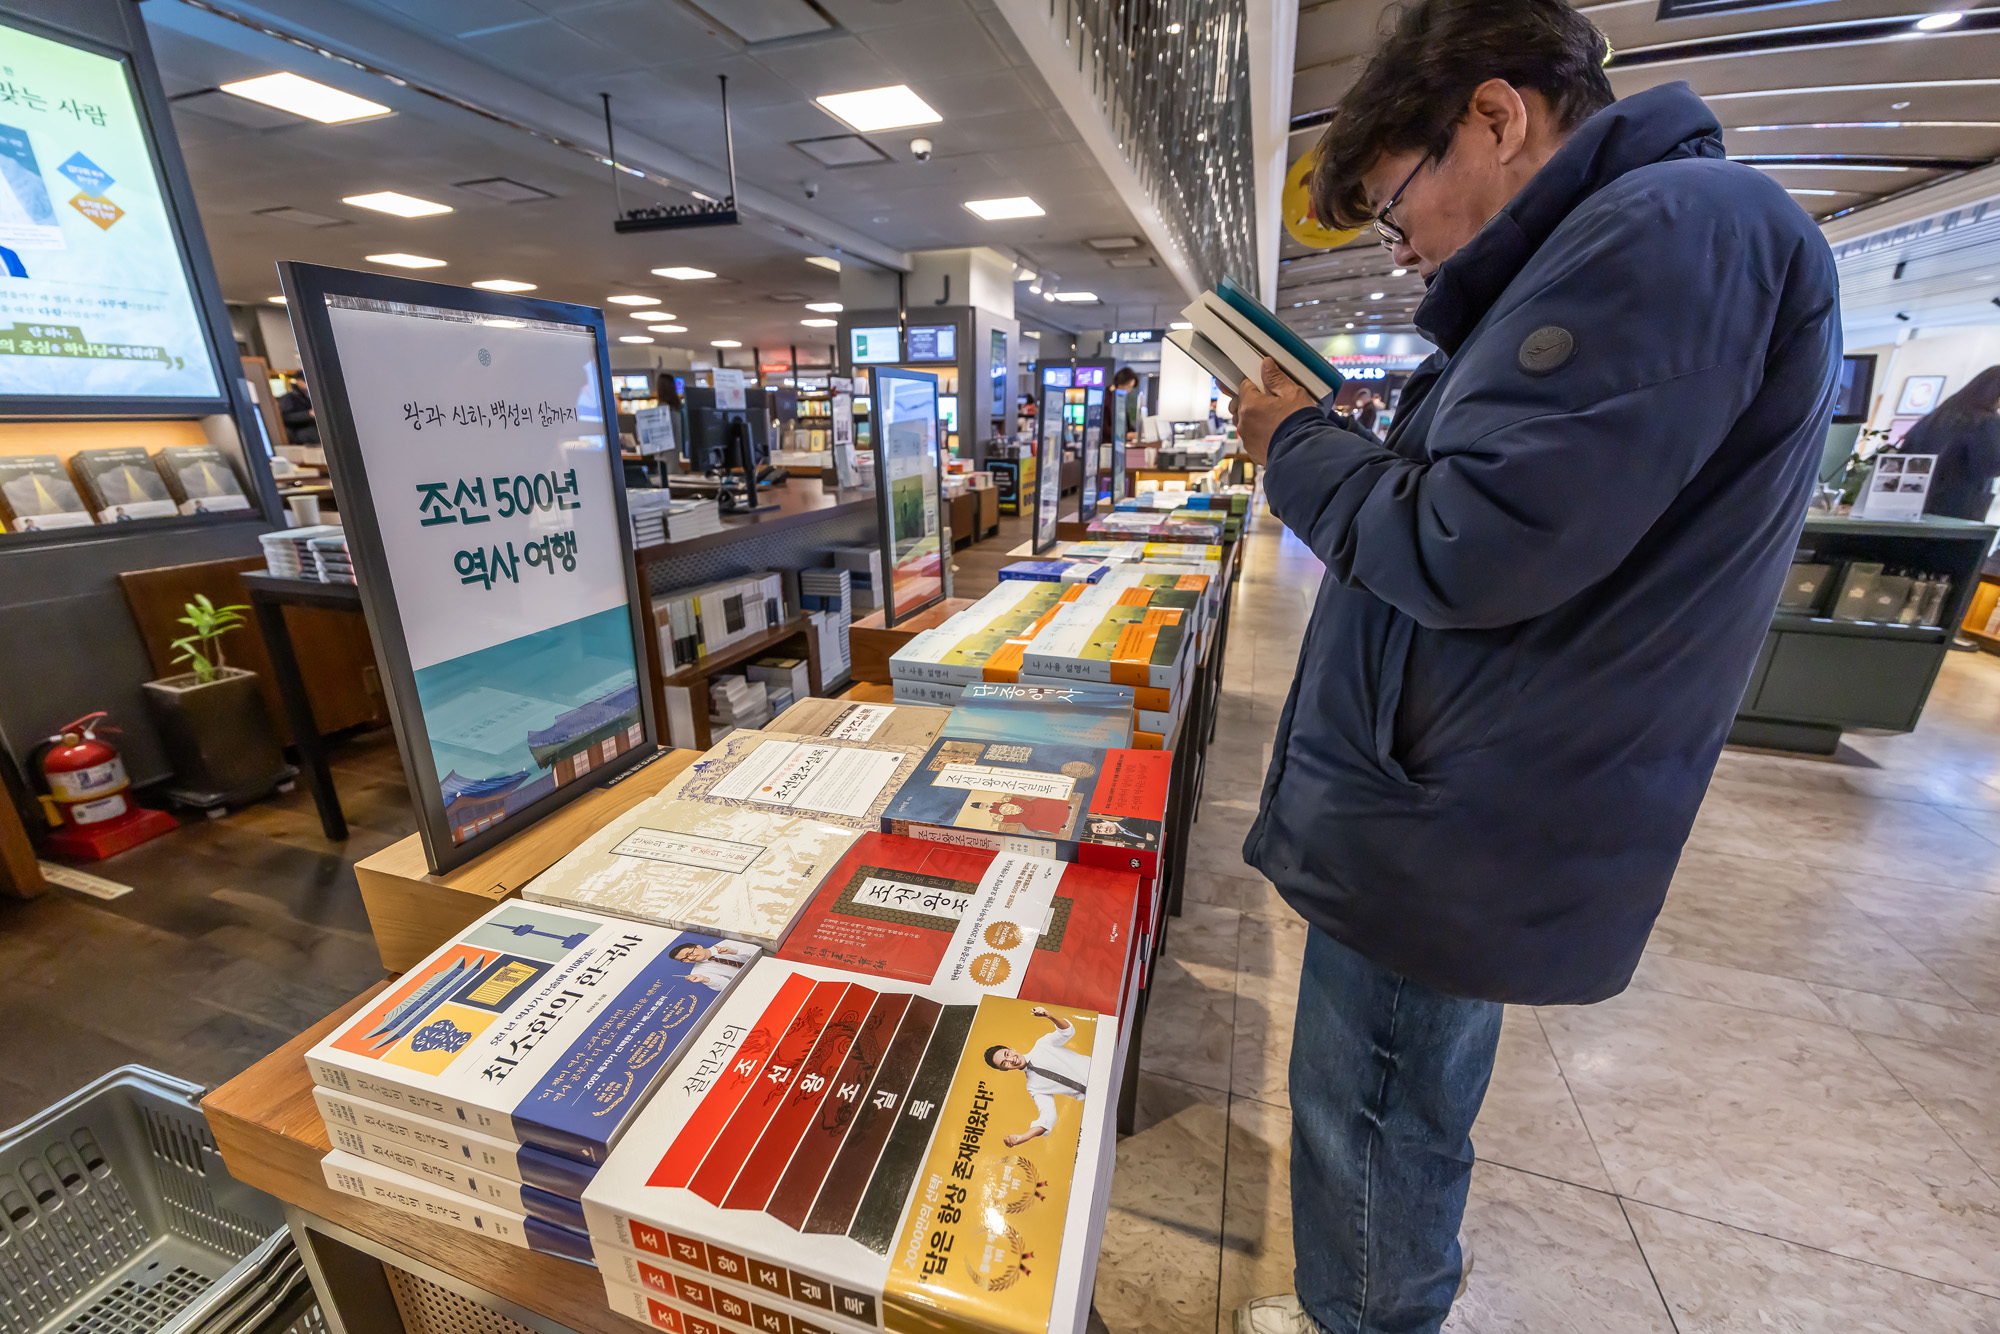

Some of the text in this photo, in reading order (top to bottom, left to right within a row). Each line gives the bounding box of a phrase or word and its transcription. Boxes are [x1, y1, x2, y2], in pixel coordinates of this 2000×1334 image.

[59, 99, 107, 127] 사람
[935, 274, 950, 306] J
[403, 401, 446, 430] 왕과
[537, 401, 578, 428] 삶까지
[416, 468, 581, 527] 조선 500년
[454, 530, 578, 590] 역사 여행
[898, 666, 907, 674] 나
[909, 668, 924, 677] 사용
[928, 669, 949, 678] 설명서
[1032, 661, 1090, 675] 나 사용 설명서
[901, 687, 910, 695] 나
[912, 689, 926, 697] 사용
[774, 749, 828, 800] 조선왕조실록
[946, 774, 1058, 794] 조선왕조실록
[632, 837, 665, 848] 단종의
[690, 845, 722, 858] 세종의
[918, 829, 992, 850] 조선왕조실록
[881, 870, 950, 887] 한 권으로 읽는
[951, 961, 962, 981] 탄탄한
[959, 944, 971, 962] 고증의
[973, 922, 983, 939] 200만
[978, 907, 989, 923] 독자가
[979, 958, 992, 978] 2017년
[985, 957, 1001, 982] 전면개정판
[480, 934, 643, 1085] 최소한의 한국사
[490, 948, 598, 1046] 5천 년 역사가 단숨에 이해되는
[552, 1069, 570, 1086] 책이
[567, 1052, 585, 1068] 역사
[584, 1009, 625, 1052] 교과서였다면
[553, 1084, 572, 1102] 역사
[570, 1057, 594, 1082] 공부가
[592, 1048, 603, 1057] 더
[601, 1032, 618, 1047] 쉽고
[616, 997, 648, 1031] 재미있었을
[584, 995, 668, 1090] 20만 독자가 선택한 역사 베스트셀러
[682, 1024, 748, 1099] 설민석의
[357, 1079, 445, 1114] 최소한의 한국사
[364, 1114, 450, 1151] 최소한의 한국사
[372, 1144, 456, 1183] 최소한의 한국사
[917, 1080, 994, 1284] “답은 항상 존재해왔다!”
[1011, 1179, 1022, 1191] 1위
[373, 1186, 462, 1222] 최소한의 한국사
[903, 1173, 943, 1271] 2000만의 선택!
[994, 1249, 1005, 1263] 1위
